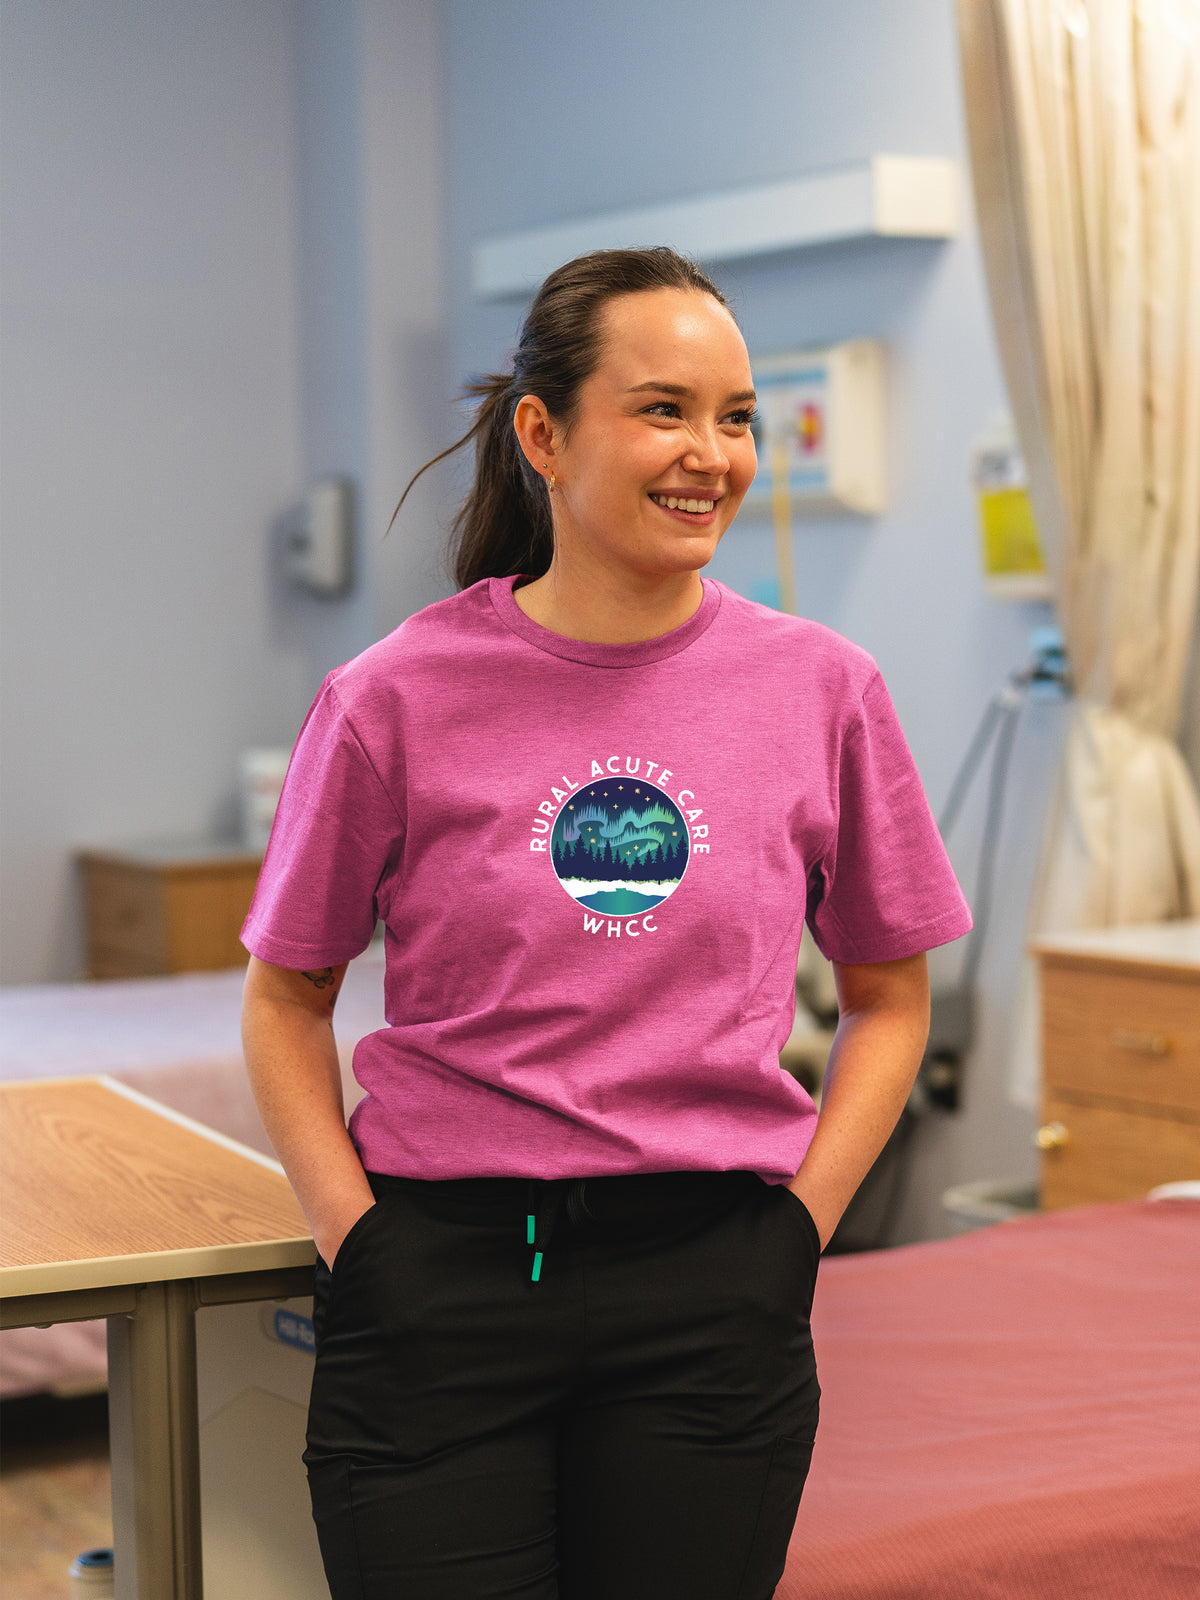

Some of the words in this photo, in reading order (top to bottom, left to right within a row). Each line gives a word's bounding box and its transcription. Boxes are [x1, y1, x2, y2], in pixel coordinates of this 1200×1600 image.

[530, 776, 579, 852] RURAL
[591, 756, 673, 787] ACUTE
[677, 790, 710, 854] CARE
[583, 914, 658, 938] WHCC
